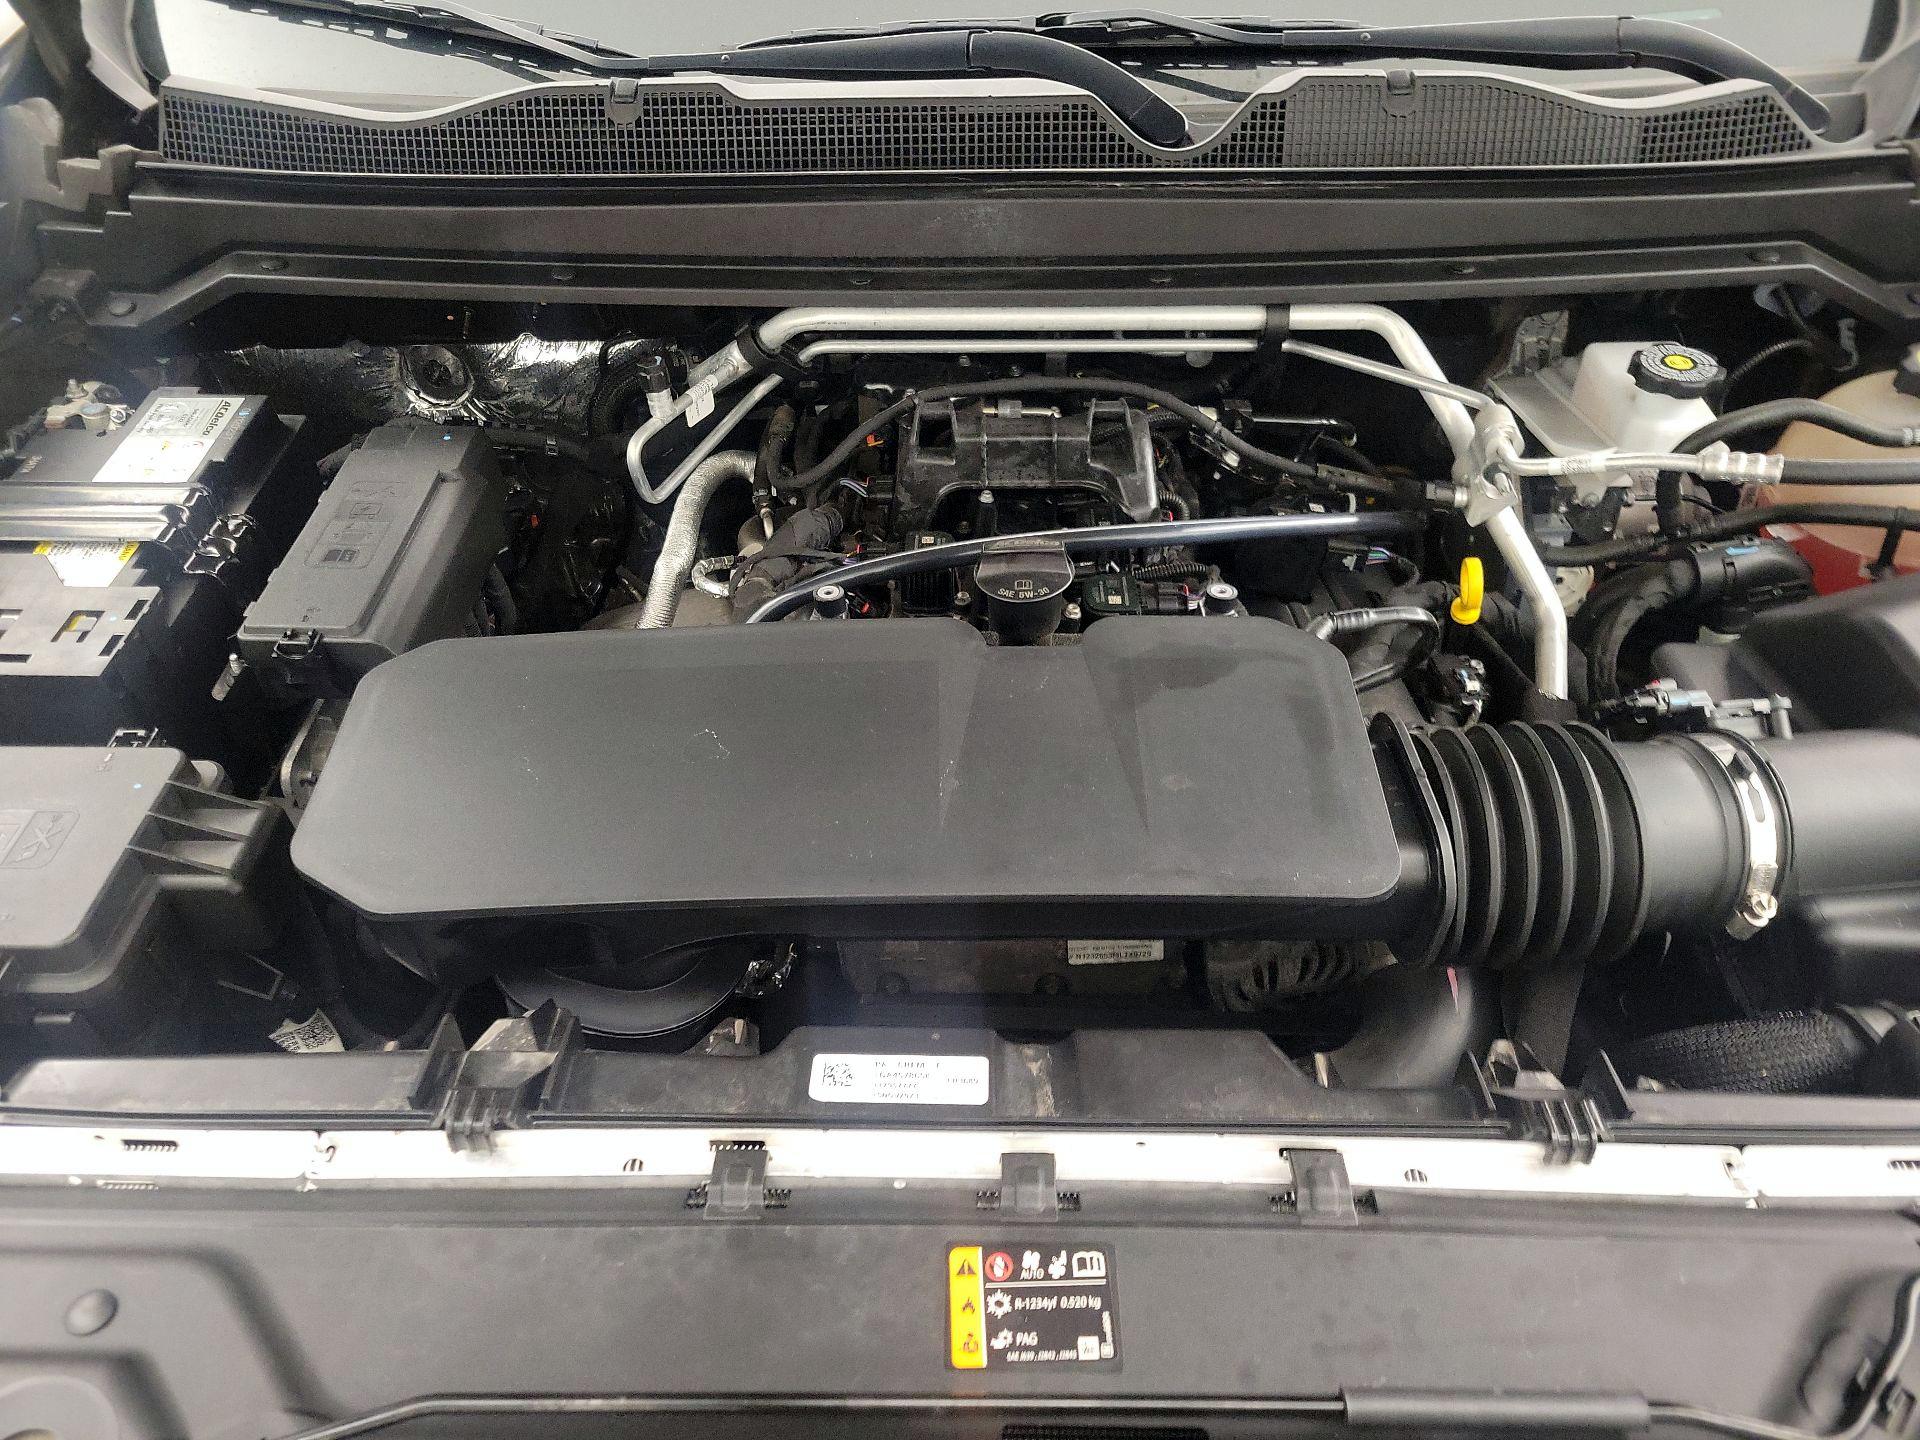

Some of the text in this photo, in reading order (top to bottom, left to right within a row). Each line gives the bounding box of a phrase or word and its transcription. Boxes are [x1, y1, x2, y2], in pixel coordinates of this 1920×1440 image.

[202, 400, 231, 436] ACDelco
[997, 586, 1050, 598] SAE 5W-30
[1020, 1268, 1044, 1280] AUTO
[1014, 1294, 1102, 1311] R-1234yf 0.520 kg
[1016, 1331, 1039, 1346] PAG
